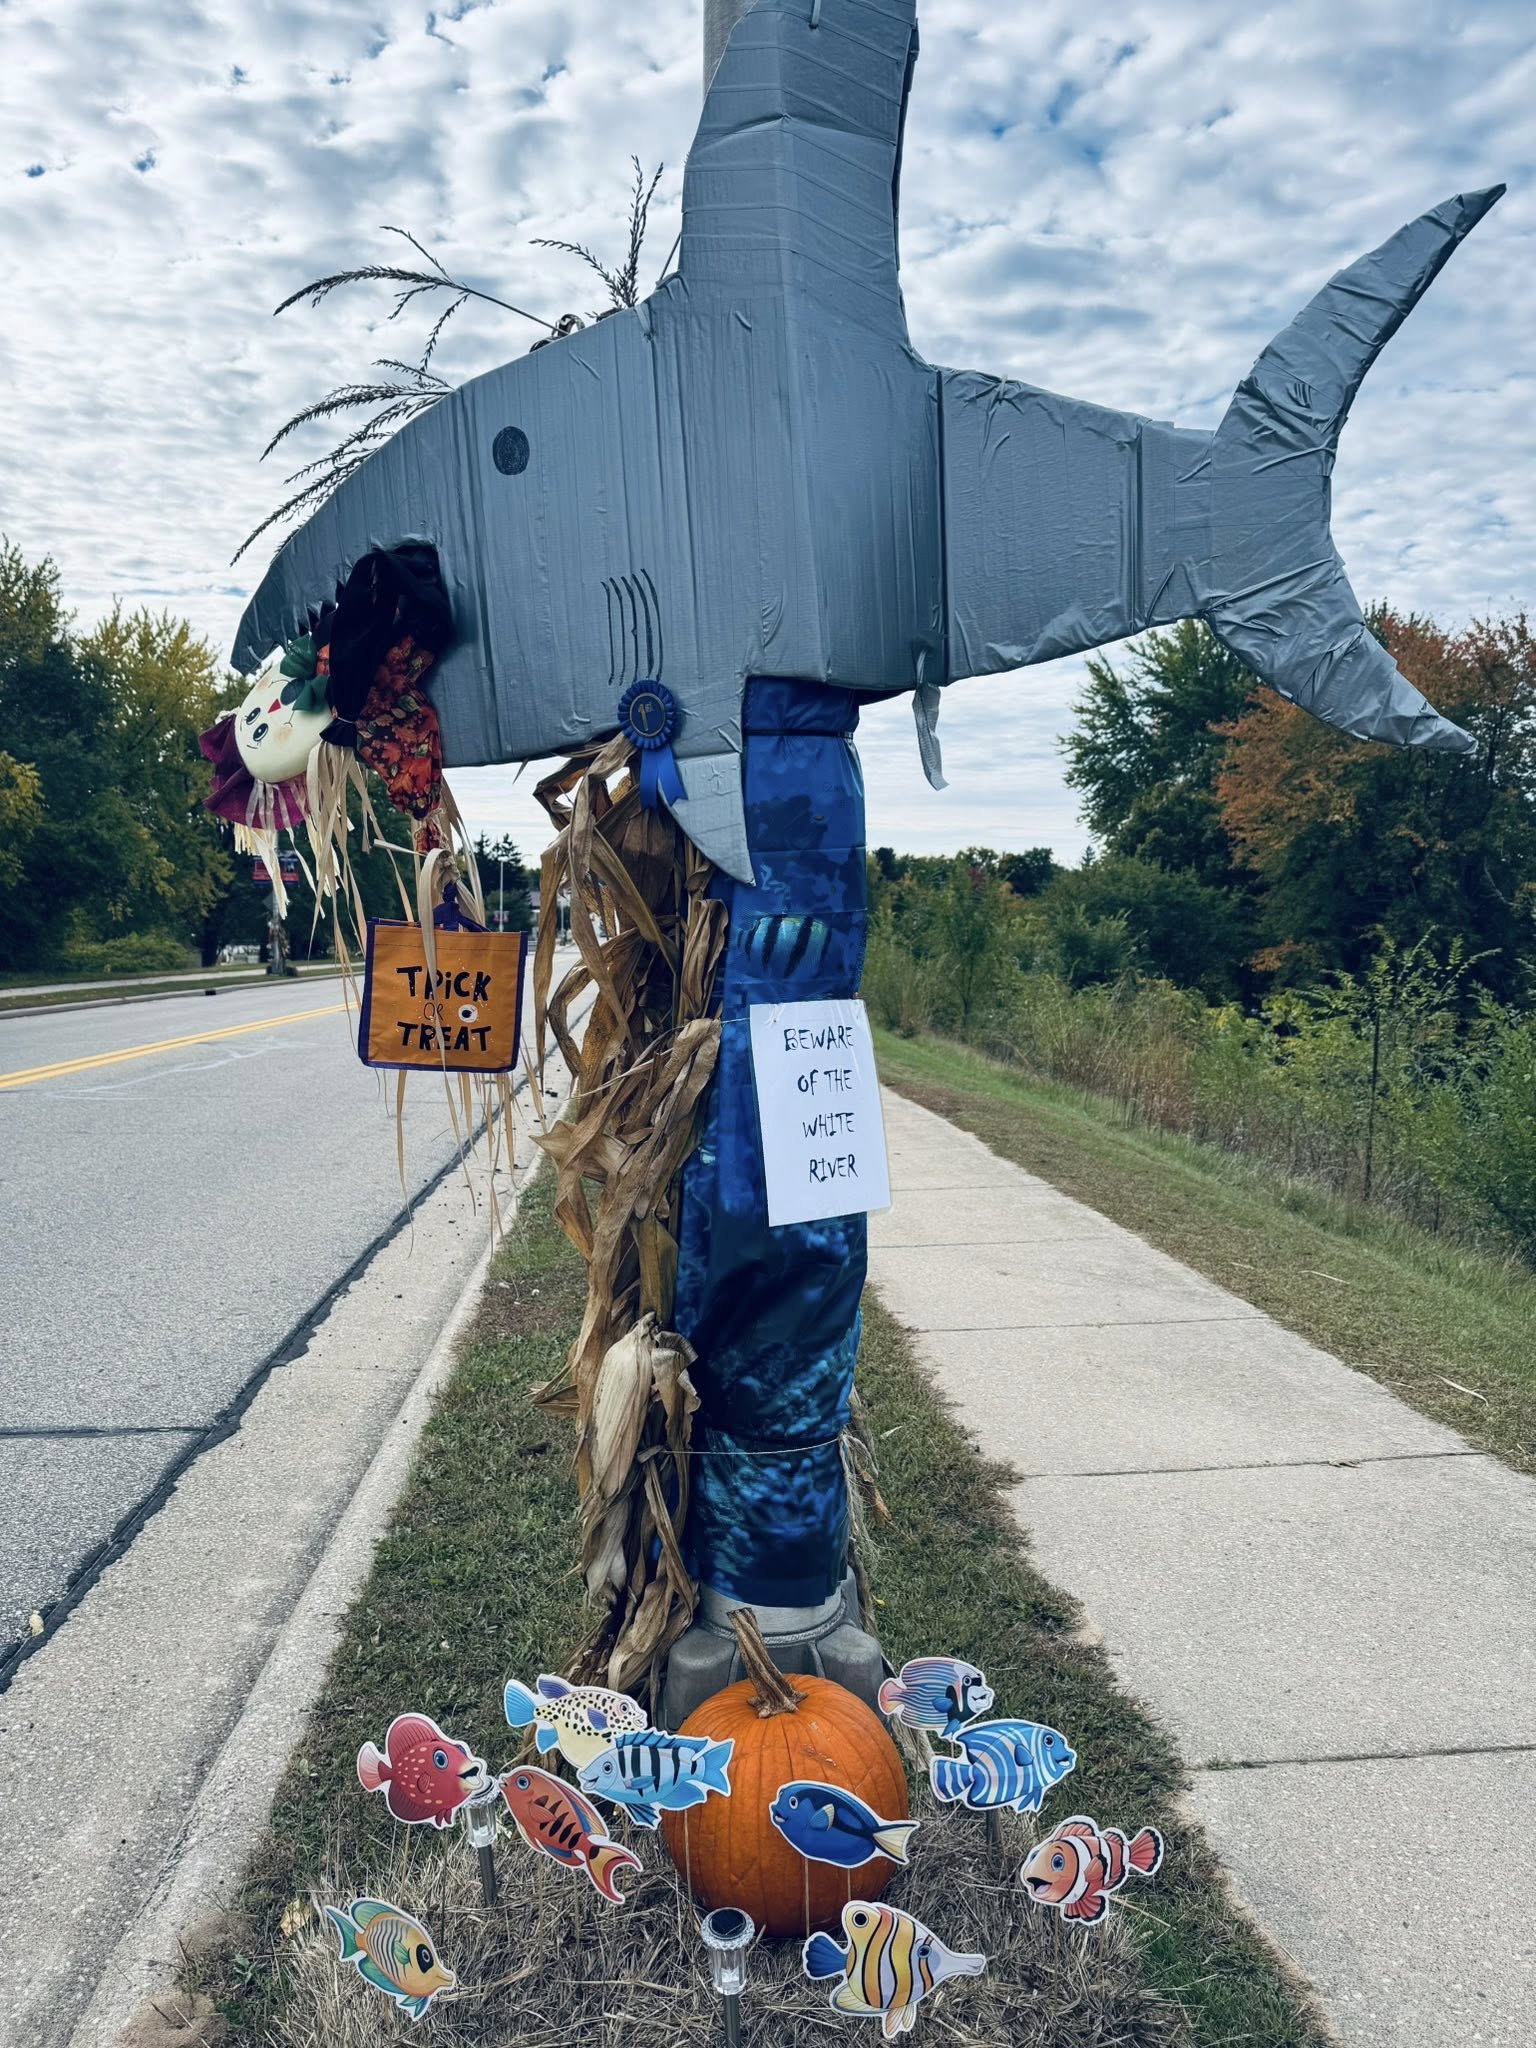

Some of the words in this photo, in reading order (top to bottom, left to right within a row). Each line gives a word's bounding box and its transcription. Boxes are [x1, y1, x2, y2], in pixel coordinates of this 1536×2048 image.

[423, 1002, 444, 1022] OR
[397, 1021, 491, 1051] TREAT
[784, 1025, 854, 1051] BEWARE
[797, 1069, 819, 1095] OF
[824, 1069, 853, 1092] THE
[803, 1112, 854, 1138] WHITE
[809, 1154, 858, 1183] RIVER
